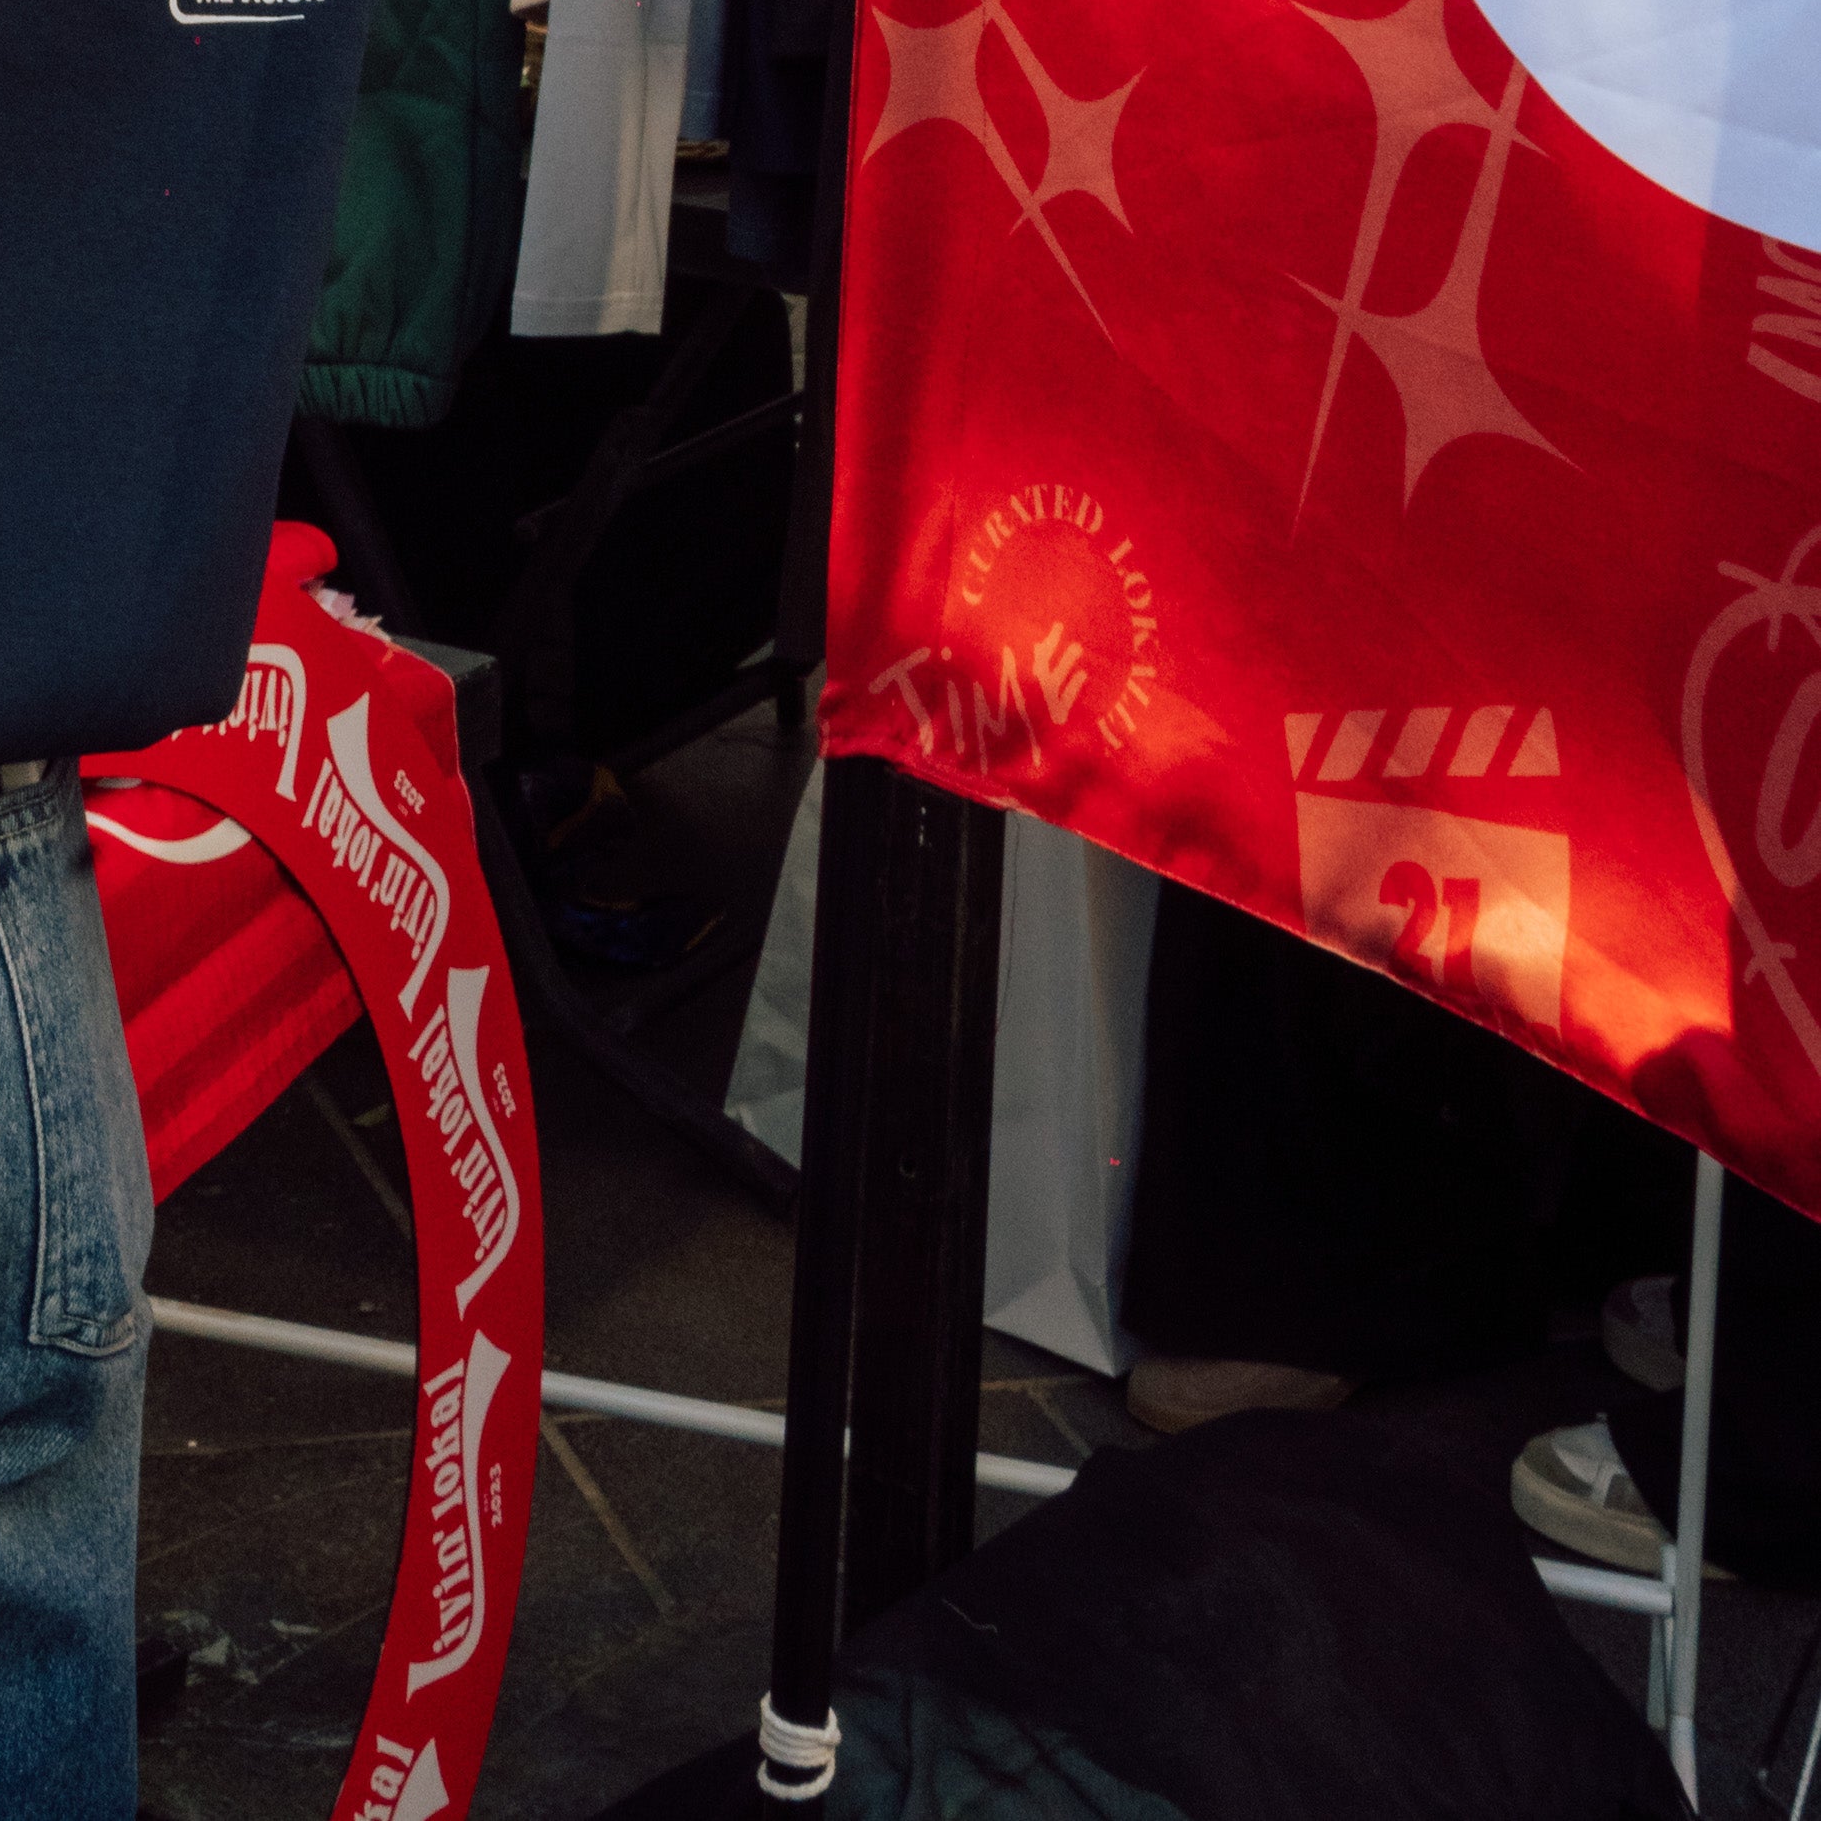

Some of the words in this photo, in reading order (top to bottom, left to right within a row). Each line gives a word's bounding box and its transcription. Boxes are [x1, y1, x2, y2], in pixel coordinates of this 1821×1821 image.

[301, 756, 383, 888] lokal
[393, 769, 427, 815] 2023
[1379, 860, 1481, 990] 21
[406, 1003, 473, 1156] lokal
[492, 1062, 517, 1119] 2023
[423, 1358, 465, 1531] lokal
[489, 1462, 503, 1529] 2023
